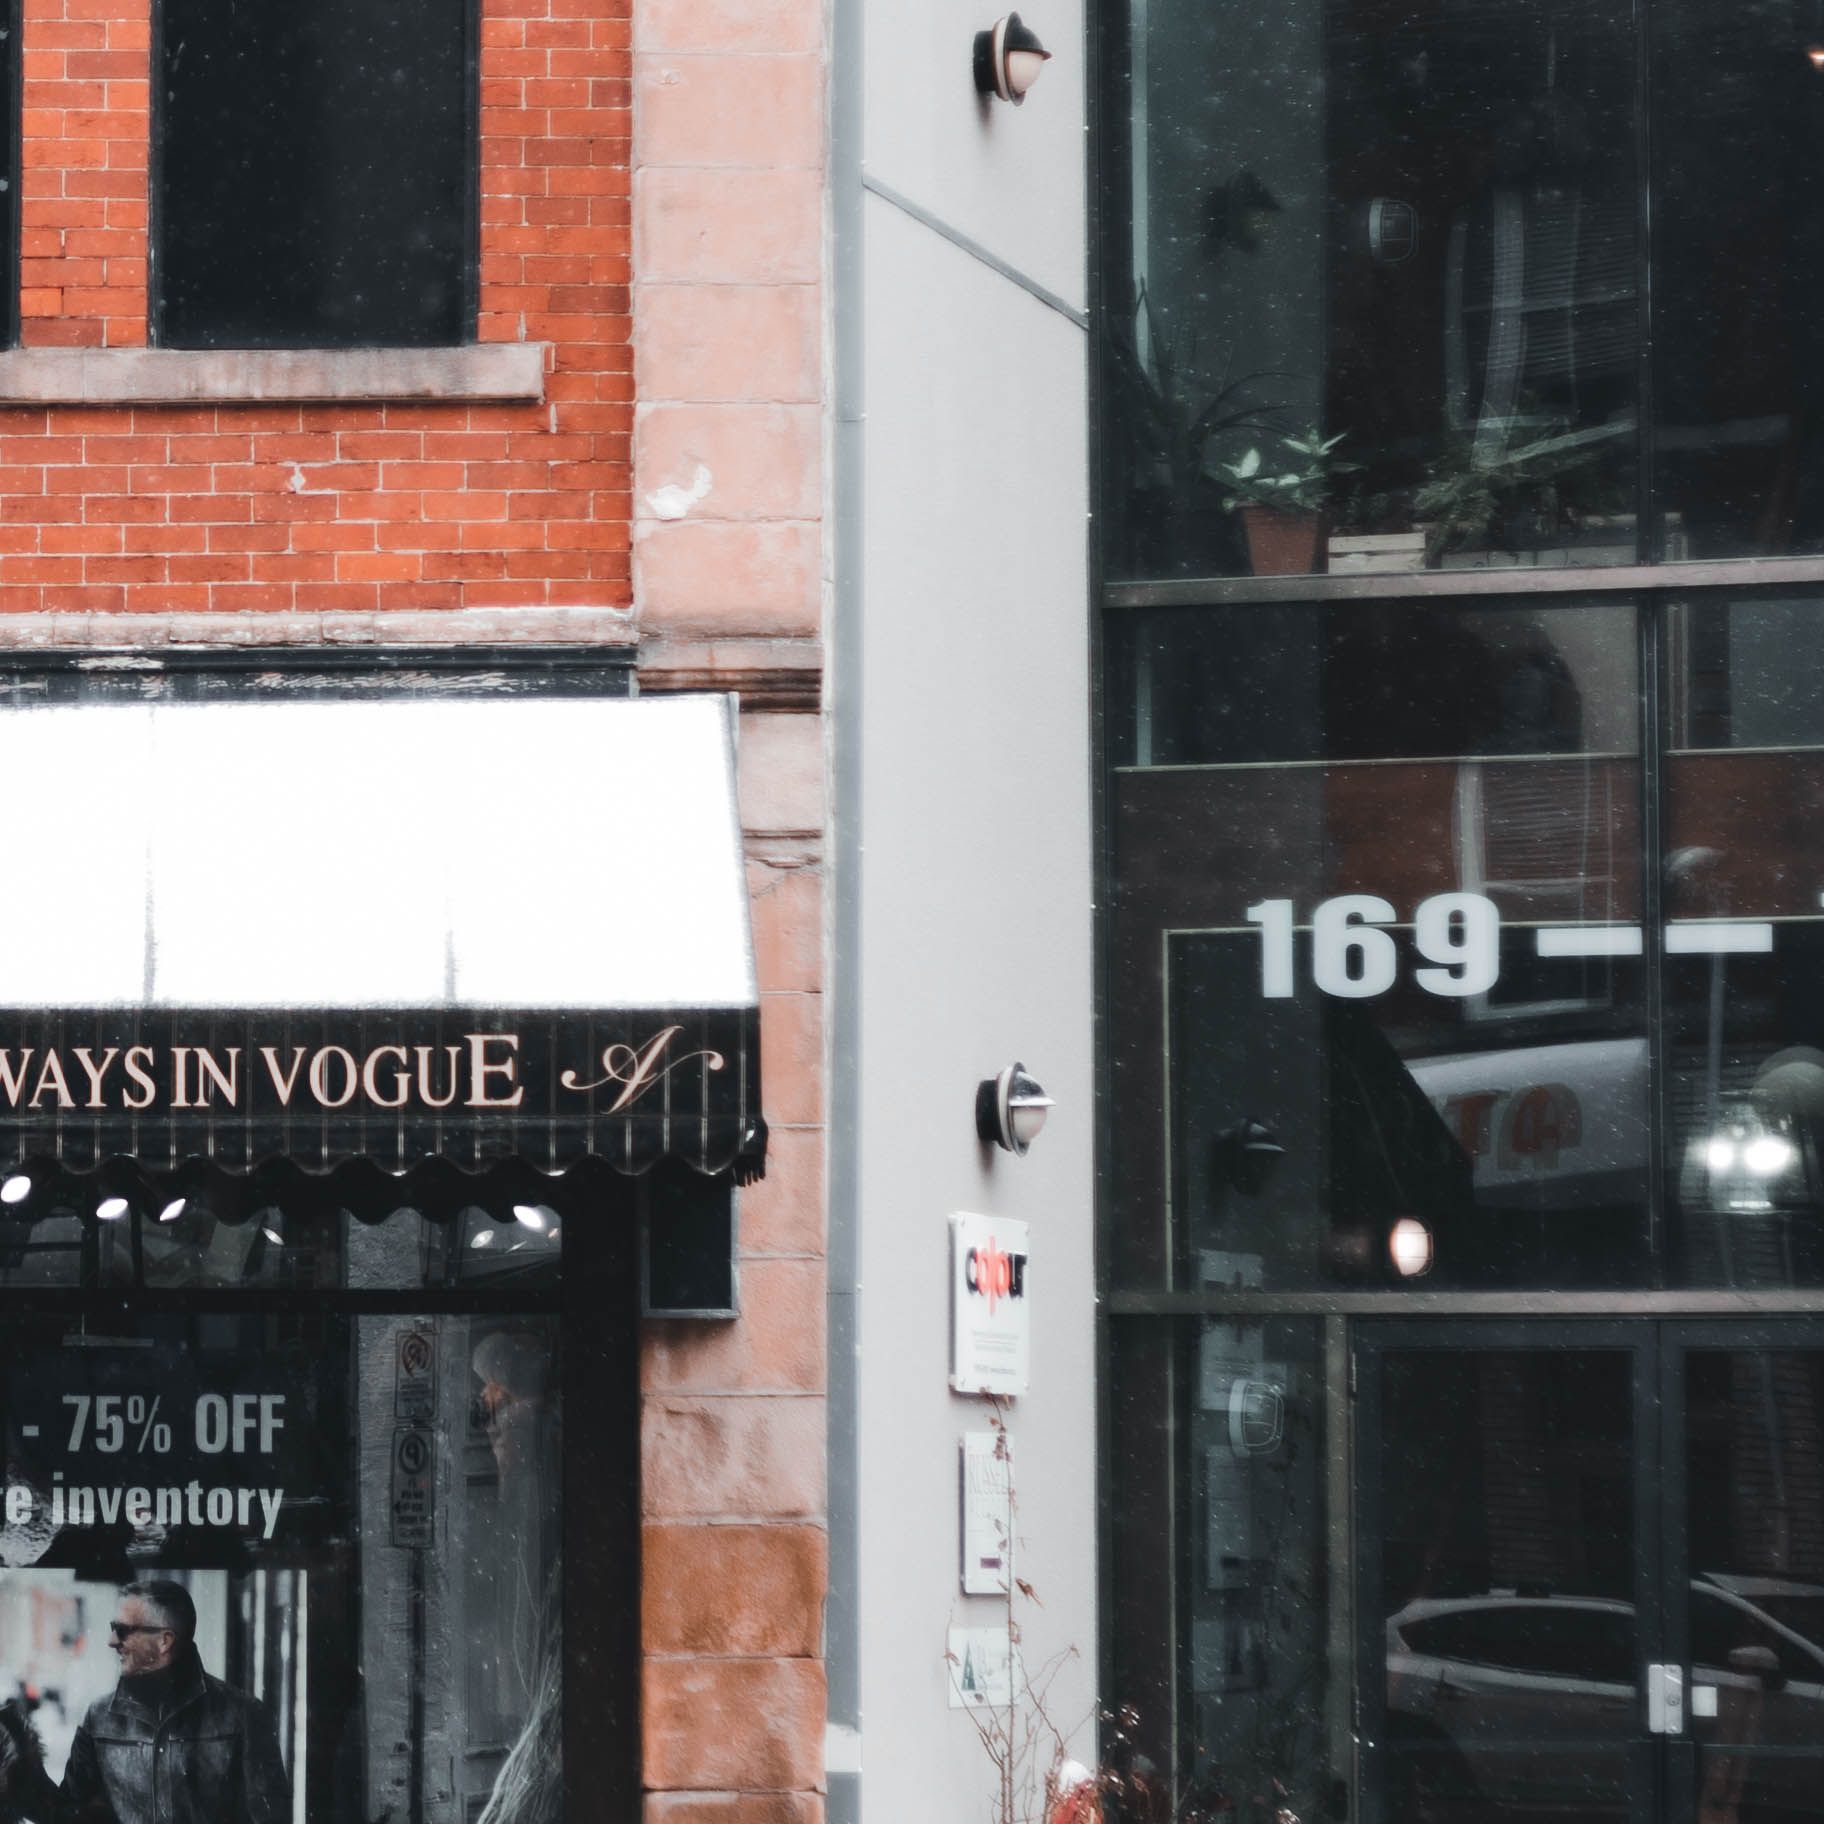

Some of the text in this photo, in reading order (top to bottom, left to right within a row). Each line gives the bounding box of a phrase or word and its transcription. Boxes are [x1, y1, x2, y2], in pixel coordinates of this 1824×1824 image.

[1245, 892, 1500, 999] 169
[169, 1046, 241, 1108] IN
[259, 1032, 524, 1108] VOGUE
[62, 1394, 172, 1454] 75%
[194, 1393, 286, 1454] OFF
[52, 1471, 284, 1539] inventory
